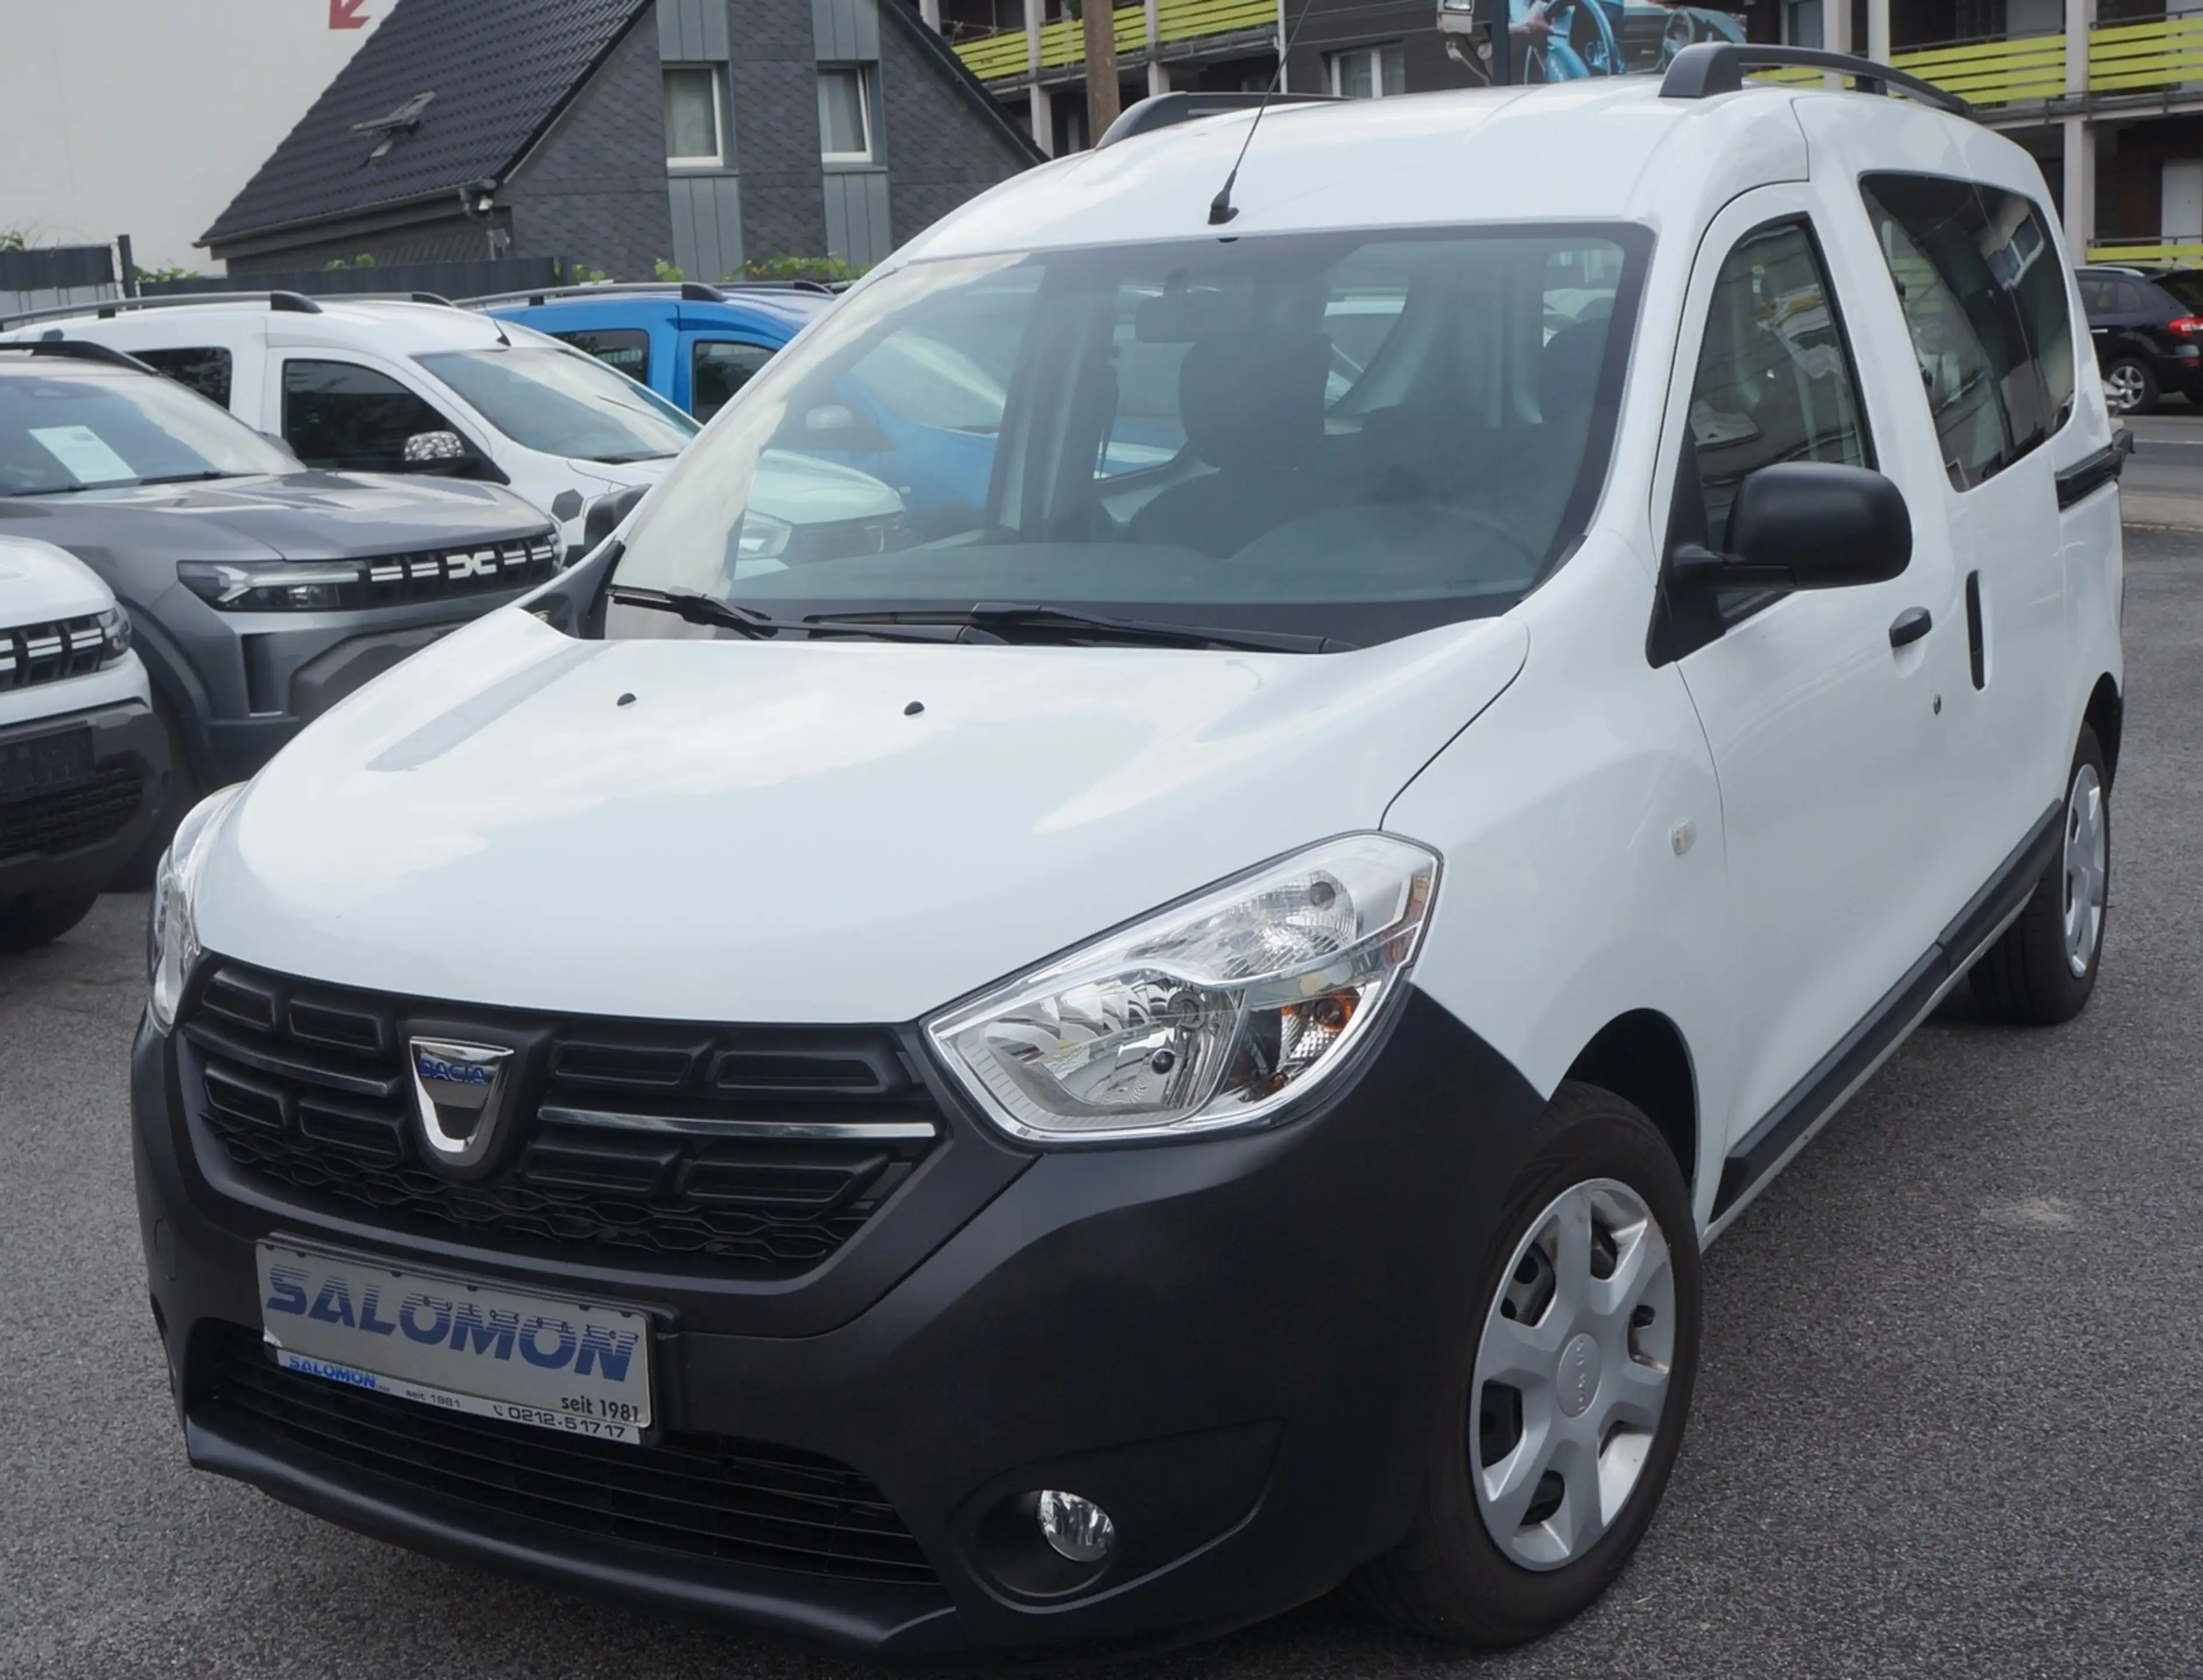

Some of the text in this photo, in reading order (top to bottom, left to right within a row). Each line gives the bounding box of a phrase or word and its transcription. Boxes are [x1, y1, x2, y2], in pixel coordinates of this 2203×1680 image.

[266, 1263, 638, 1382] SALOMON
[289, 1355, 377, 1389] SALOMON
[561, 1395, 639, 1422] seit 1981
